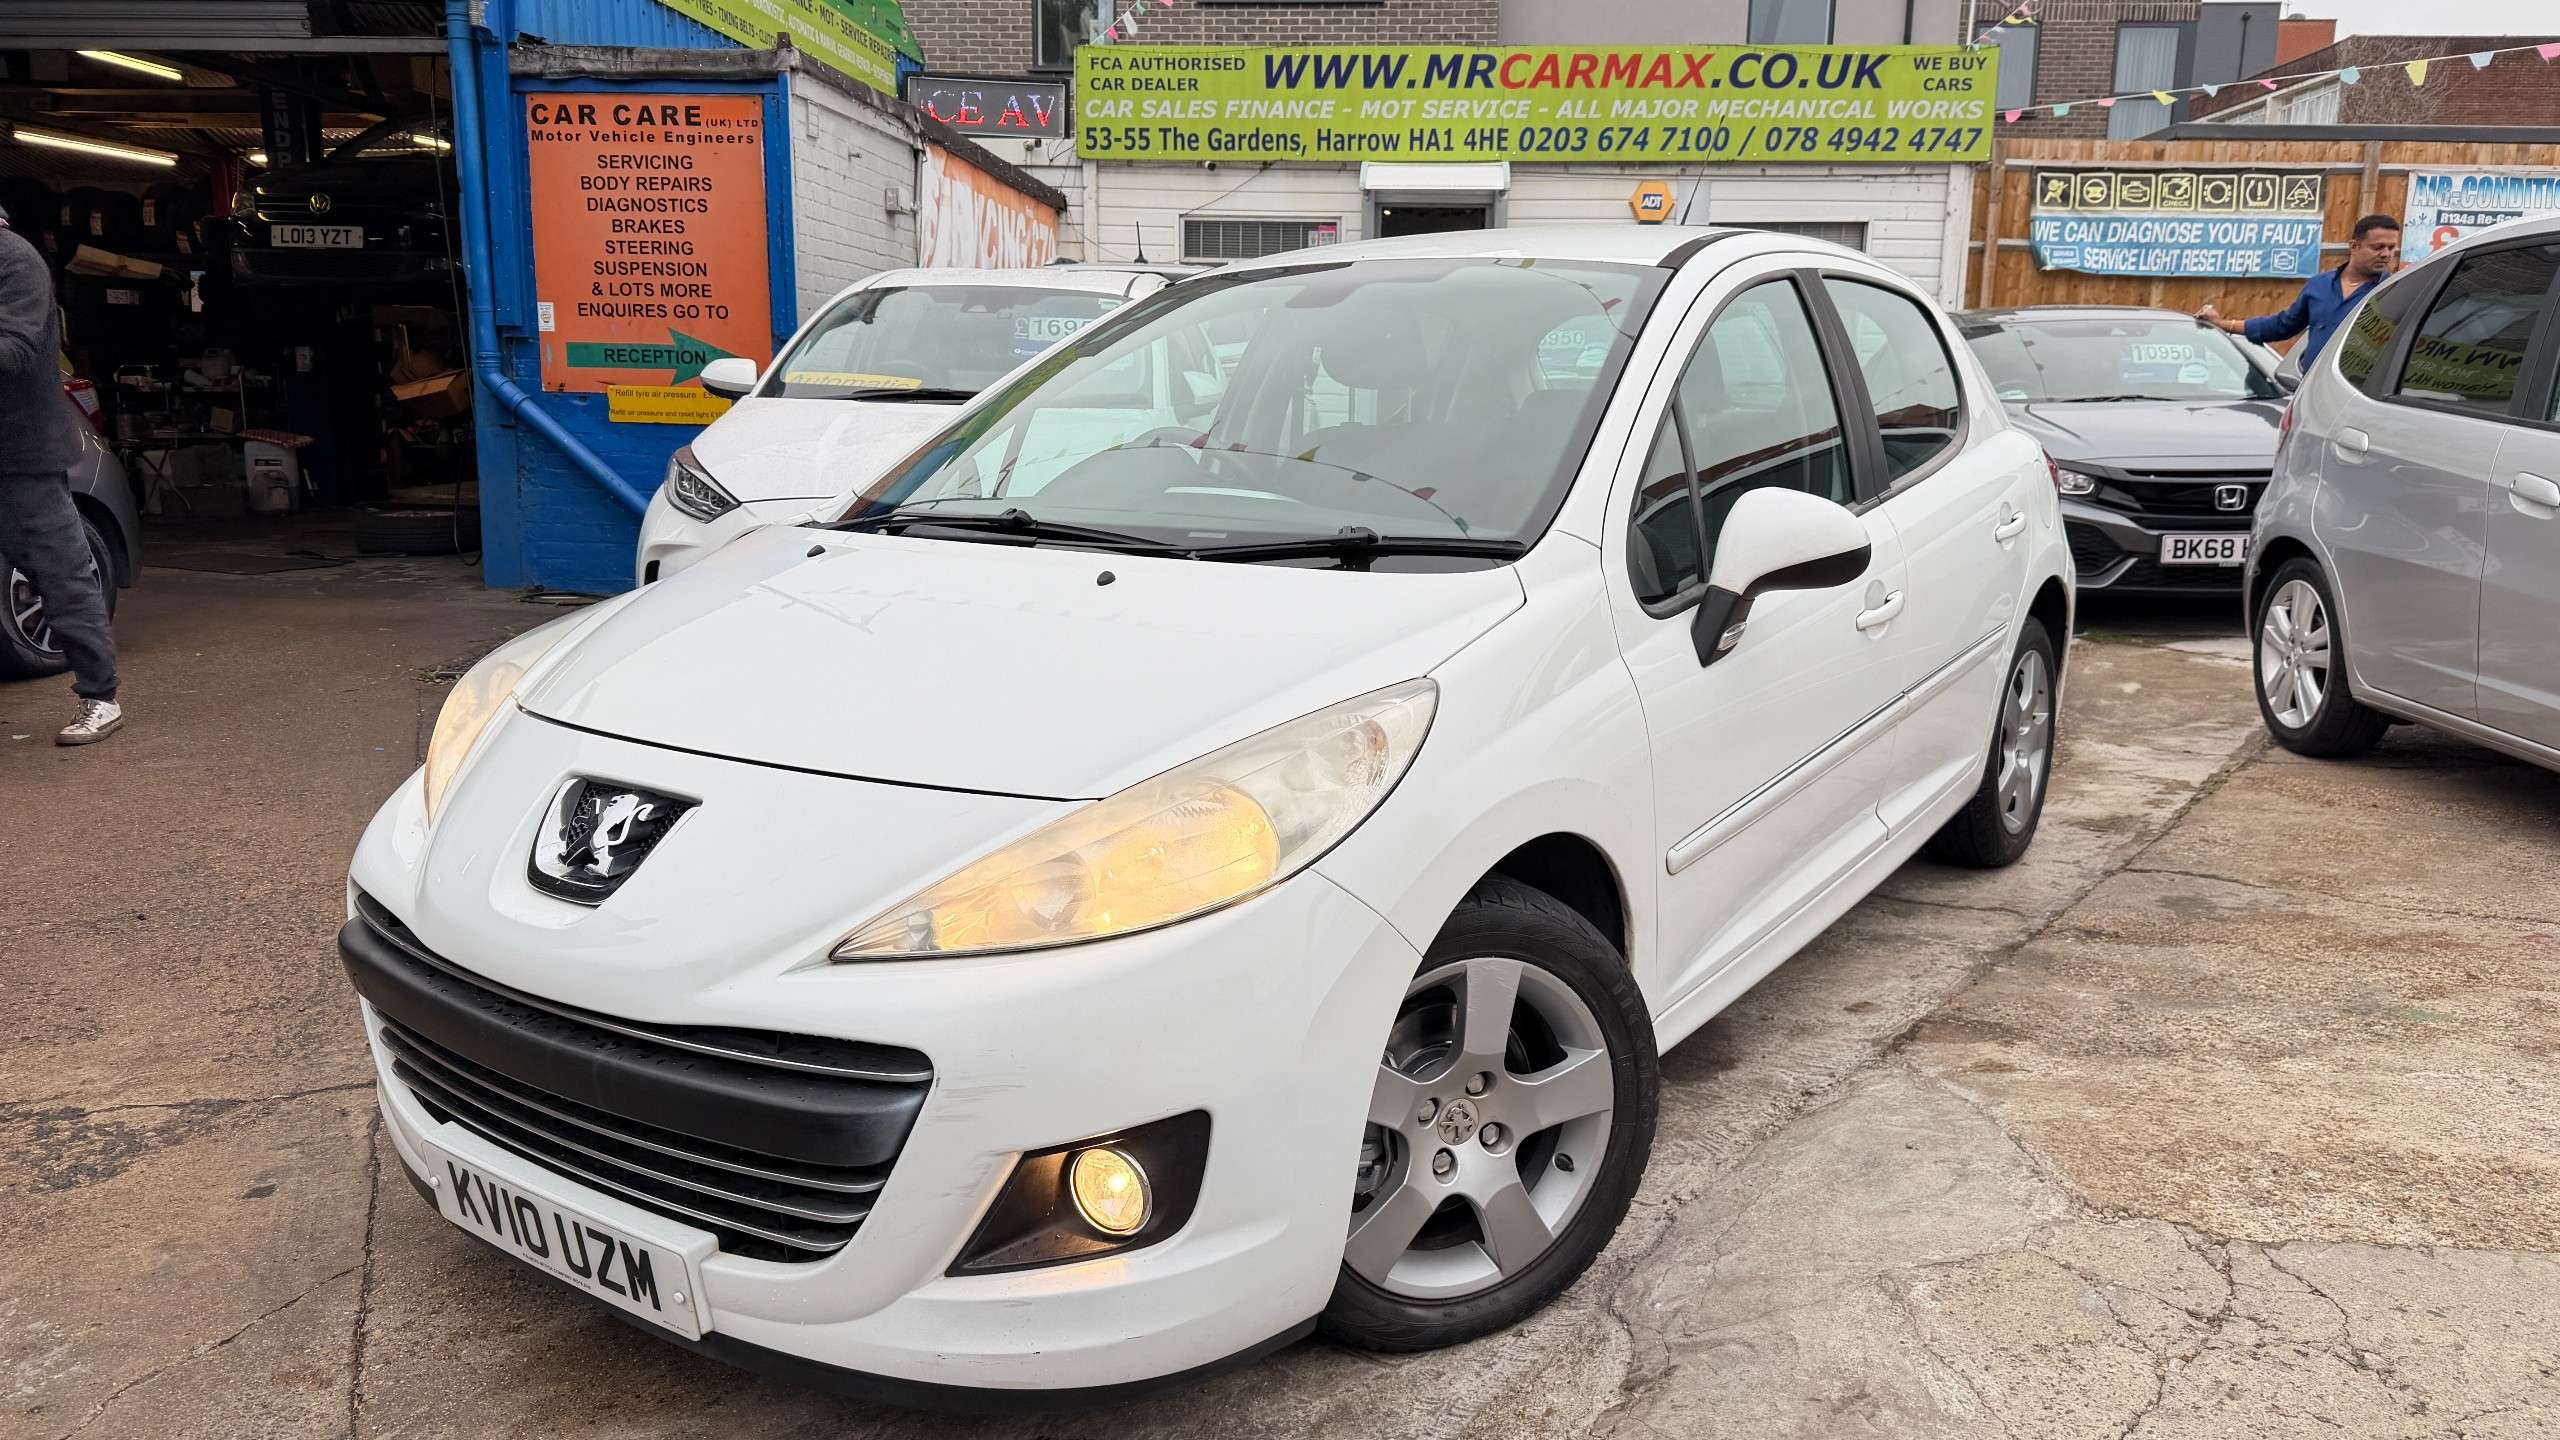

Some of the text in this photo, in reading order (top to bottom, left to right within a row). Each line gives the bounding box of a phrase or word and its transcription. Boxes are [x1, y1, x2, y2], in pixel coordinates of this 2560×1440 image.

[820, 4, 834, 27] MOT
[840, 18, 868, 49] SERVICE
[869, 36, 895, 64] REPAIRS
[1090, 57, 1245, 71] FCA AUTHORISED
[1264, 53, 1889, 90] WWW.MRCARMAX.CO.UK
[1913, 56, 1987, 71] WE BUY
[1090, 77, 1199, 92] CAR DEALER
[1922, 77, 1973, 92] CARS
[530, 104, 758, 128] CAR CARE (UK) LTD
[1085, 99, 1136, 119] CAR
[1140, 99, 1219, 119] SALES
[1224, 99, 1334, 119] FINANCE
[1360, 99, 1417, 119] MOT
[1421, 99, 1531, 119] SERVICE
[1555, 99, 1600, 119] ALL
[1611, 99, 1697, 119] MAJOR
[1704, 99, 1877, 119] MECHANICAL
[1887, 99, 1985, 119] WORKS
[531, 130, 754, 146] Motor Vehicle Engineers
[1085, 126, 1151, 151] 53-55
[1159, 126, 1199, 151] The
[1207, 126, 1307, 156] Gardens,
[1317, 128, 1400, 152] Harrow
[1409, 128, 1454, 152] HA1
[1463, 128, 1509, 152] 4HE
[1518, 126, 1588, 152] 0203
[1597, 126, 1649, 152] 674
[1660, 126, 1731, 152] 7100
[1765, 126, 1818, 152] 078
[1827, 126, 1900, 152] 4942
[1909, 126, 1983, 152] 4747
[597, 155, 693, 170] SERVICING
[581, 176, 712, 192] BODY REPAIRS
[587, 197, 708, 213] DIAGNOSTICS
[1641, 195, 1662, 209] ADT
[612, 219, 685, 234] BRAKES
[2035, 221, 2317, 245] WE CAN DIAGNOSE YOUR FAULT
[280, 228, 352, 245] LO13 YZT
[605, 240, 694, 256] STEERING
[2084, 247, 2137, 270] SERVICE
[2138, 248, 2180, 271] LIGHT
[2182, 248, 2225, 272] RESET
[2226, 249, 2262, 272] HERE
[593, 261, 707, 277] SUSPENSION
[592, 282, 712, 298] & LOTS MORE
[577, 303, 729, 320] ENQUIRES GO TO
[604, 349, 706, 365] RECEPTION
[2132, 345, 2193, 362] 10950
[615, 389, 634, 397] Refill
[635, 390, 650, 399] tyre
[664, 392, 696, 401] pressure
[637, 410, 664, 418] pressure
[2172, 538, 2234, 559] BK68
[447, 1160, 662, 1312] KV10 UZM
